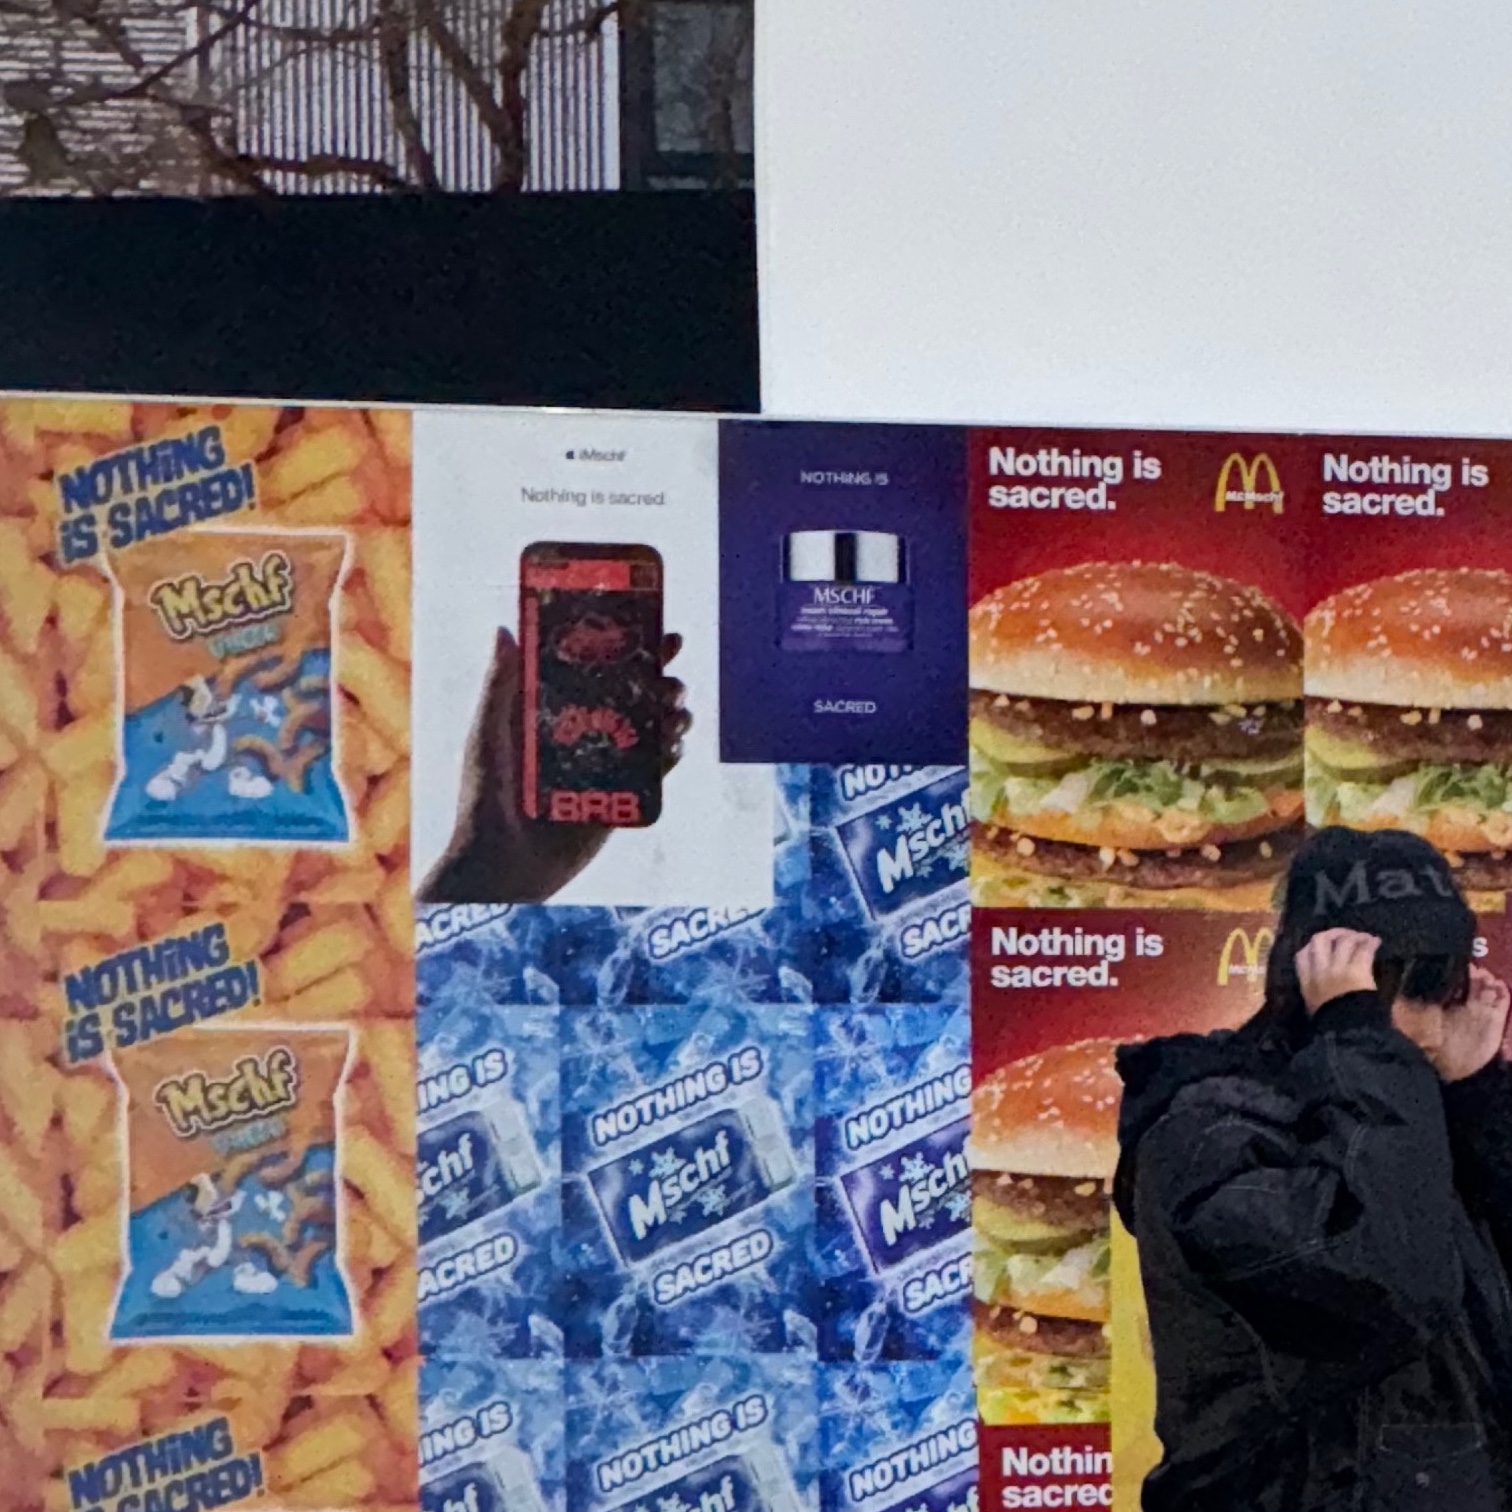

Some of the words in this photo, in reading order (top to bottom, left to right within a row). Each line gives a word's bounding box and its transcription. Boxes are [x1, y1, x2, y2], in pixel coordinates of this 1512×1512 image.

[800, 471, 872, 485] NOTHING
[874, 472, 889, 486] IS
[988, 446, 1124, 485] Nothing
[1132, 450, 1162, 480] is
[1322, 453, 1452, 492] Nothing
[1461, 458, 1490, 488] is
[106, 462, 256, 549] SACRED!
[521, 486, 587, 507] Nothing
[591, 489, 605, 504] is
[988, 481, 1117, 511] sacred.
[1322, 489, 1446, 517] sacred.
[150, 551, 291, 638] Mschf
[814, 586, 876, 605] MSCHF
[814, 700, 877, 714] SACRED
[991, 926, 1126, 962] Nothing
[1135, 927, 1164, 957] is
[991, 960, 1119, 988] sacred.
[111, 959, 261, 1048] SACRED!
[472, 1048, 508, 1087] IS
[154, 1045, 296, 1137] Mschf
[591, 1061, 730, 1147] NOTHING
[728, 1046, 764, 1084] IS
[628, 1130, 730, 1241] Mschf
[652, 1228, 774, 1305] SACRED
[477, 1400, 514, 1439] IS
[597, 1411, 734, 1493] NOTHING
[732, 1394, 769, 1430] IS
[848, 1417, 979, 1502] NOTHING
